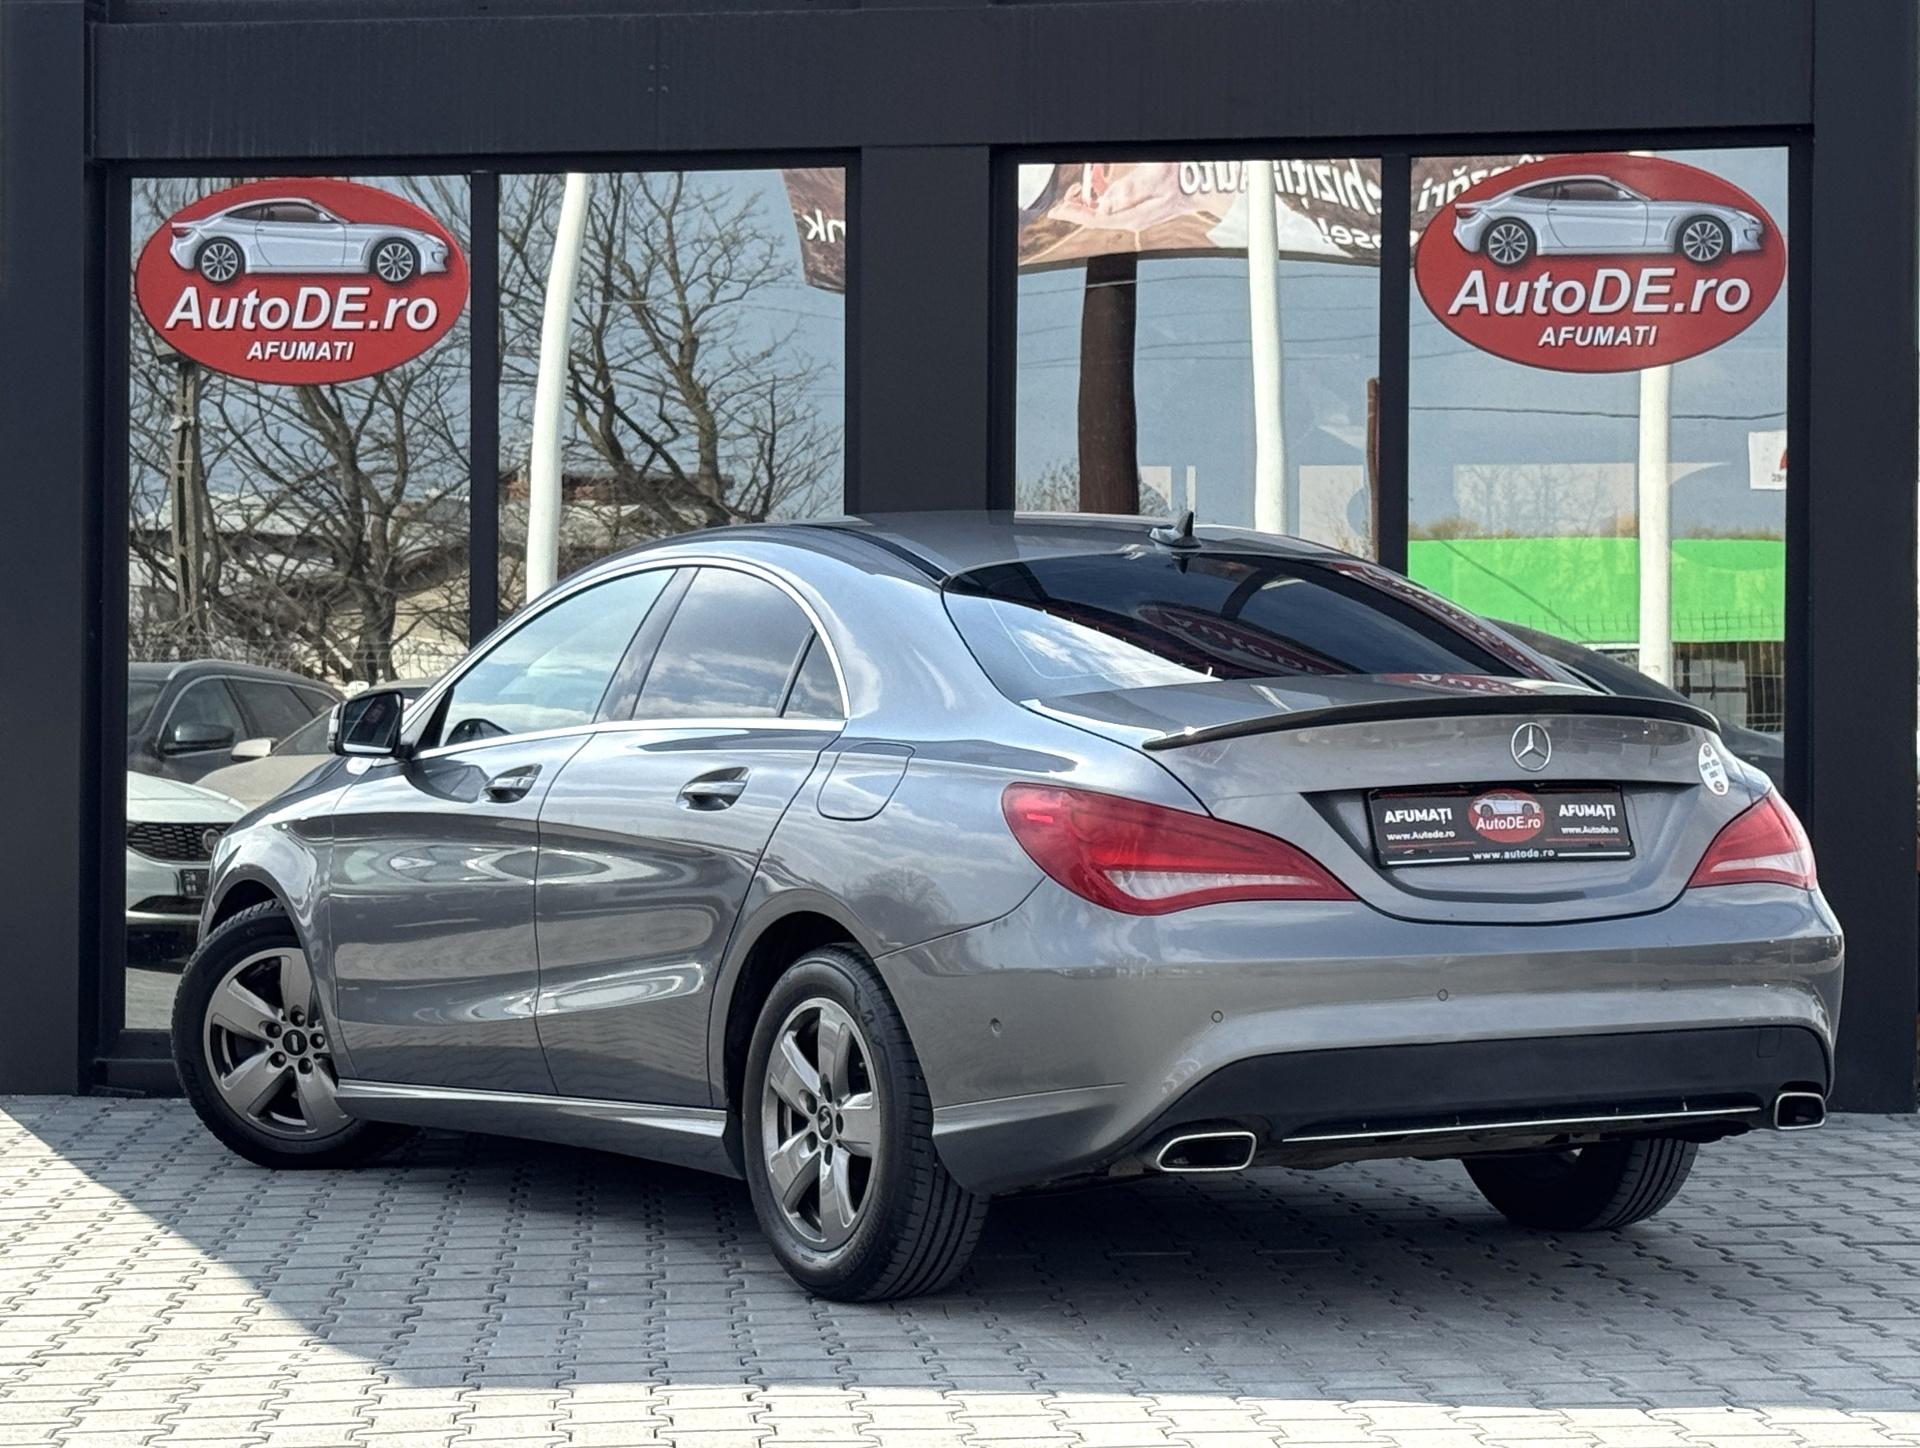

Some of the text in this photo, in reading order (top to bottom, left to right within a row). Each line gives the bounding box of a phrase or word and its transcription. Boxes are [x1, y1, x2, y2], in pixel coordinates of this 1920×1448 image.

[1447, 267, 1751, 315] AutoDE.ro
[164, 286, 438, 331] AutoDE.ro
[1538, 325, 1659, 347] AFUMATI
[246, 341, 355, 361] AFUMATI
[1475, 815, 1541, 831] AutoDE.ro
[1472, 848, 1555, 860] www.autode.ro
